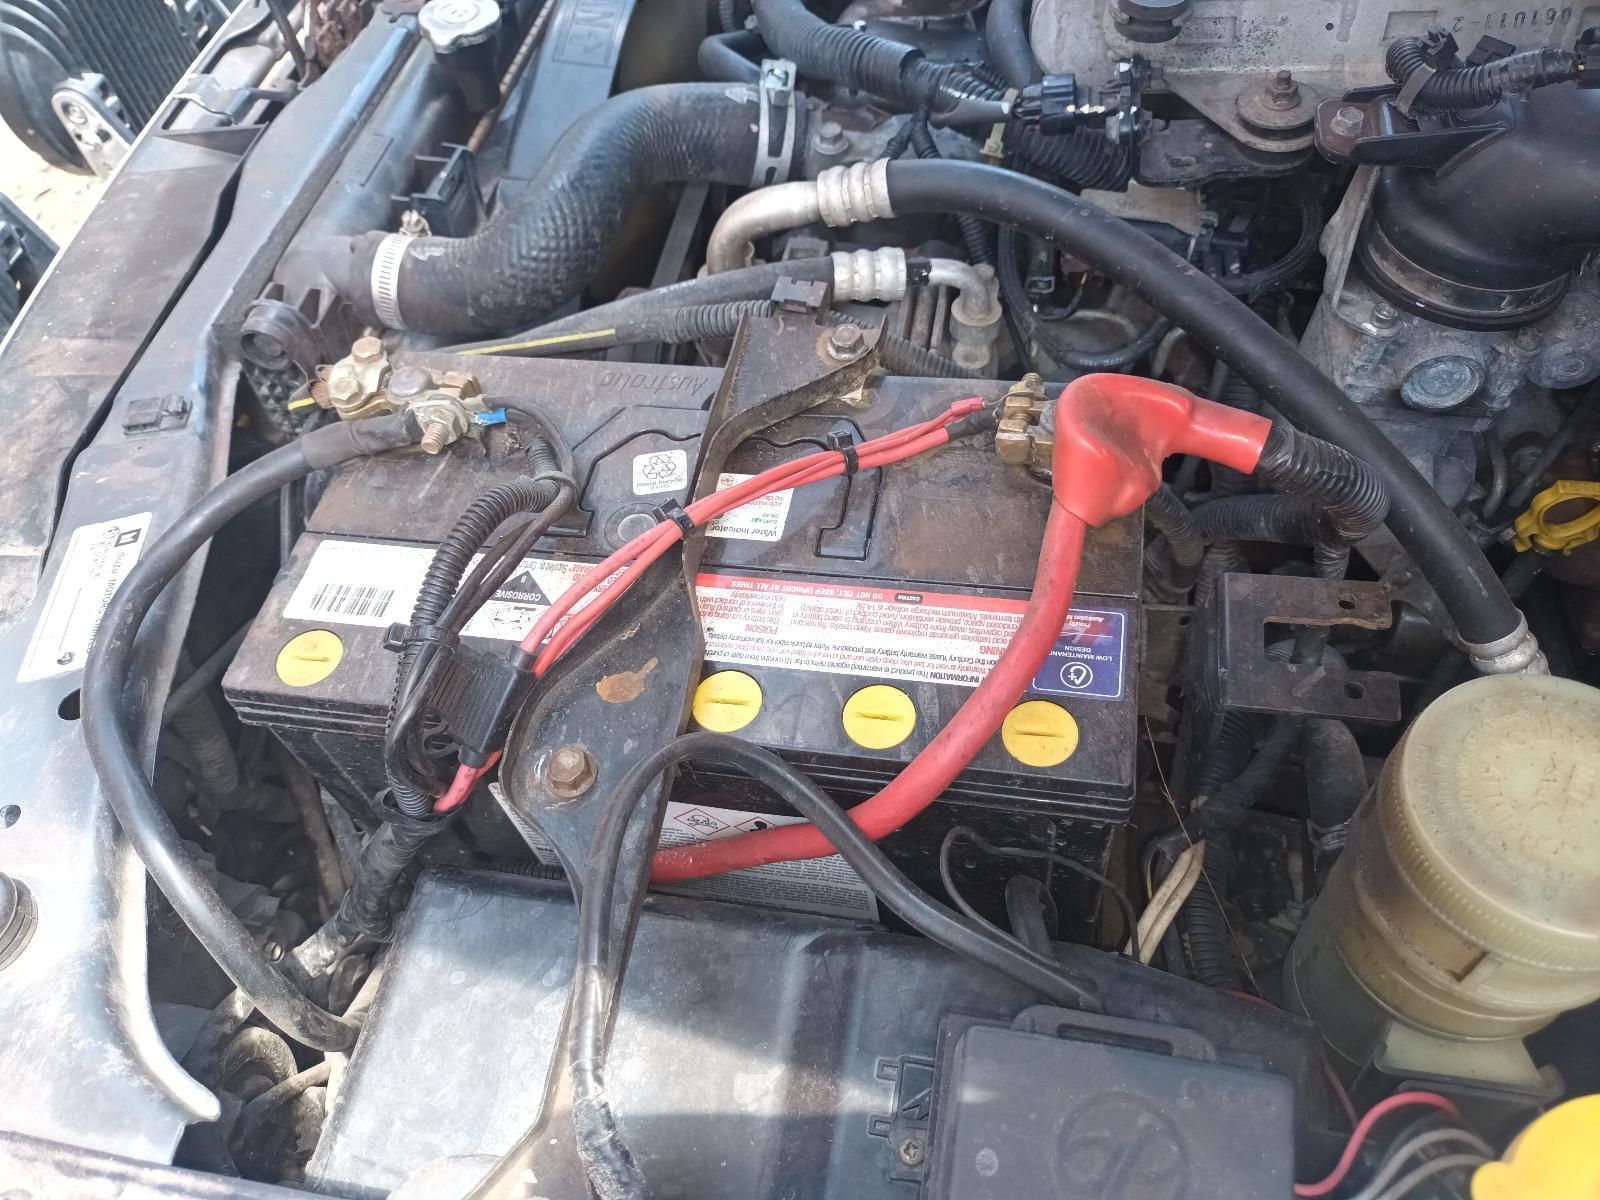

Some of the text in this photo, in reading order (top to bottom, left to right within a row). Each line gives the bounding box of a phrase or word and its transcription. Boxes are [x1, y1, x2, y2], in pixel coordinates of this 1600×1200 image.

[710, 525, 777, 537] Water Indicator
[520, 575, 526, 583] 8
[731, 580, 753, 588] TIMES
[753, 582, 768, 590] ALL
[769, 583, 780, 591] AT
[780, 584, 813, 593] UPRIGHT
[494, 589, 541, 601] CORROSIVE
[814, 587, 834, 596] KEEP
[1073, 614, 1103, 622] Australian
[1068, 620, 1090, 628] Proudly
[744, 623, 778, 635] POISON
[960, 635, 991, 643] batteries
[876, 648, 898, 657] battery
[899, 650, 927, 659] warranty
[979, 645, 1006, 655] NING
[1047, 650, 1094, 659] MAINTENANC
[928, 653, 947, 661] Yuasa
[948, 655, 973, 663] Century
[826, 660, 850, 669] against
[850, 664, 883, 672] warranted
[956, 664, 986, 673] Warranty
[890, 666, 914, 675] product
[929, 671, 979, 683] INFORMATION
